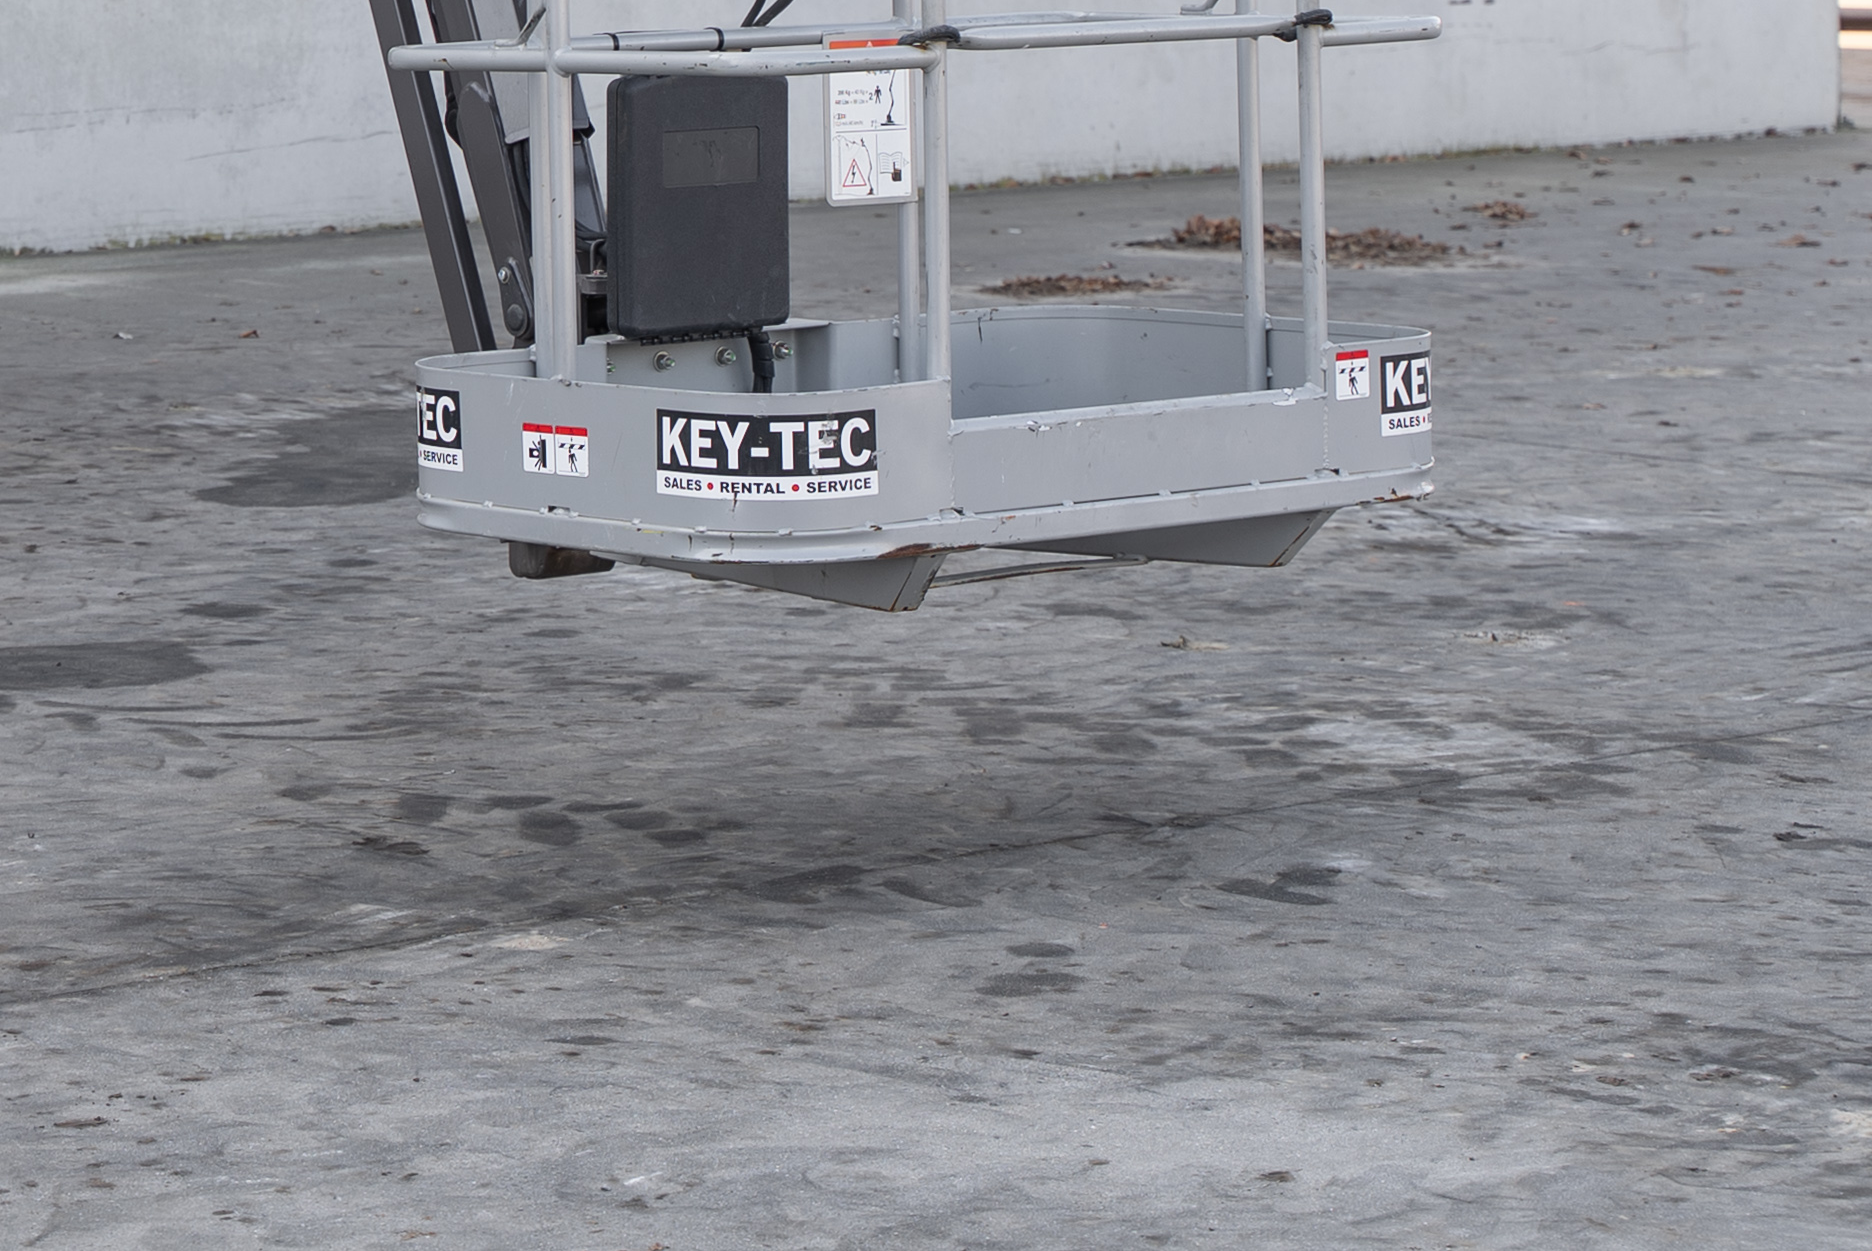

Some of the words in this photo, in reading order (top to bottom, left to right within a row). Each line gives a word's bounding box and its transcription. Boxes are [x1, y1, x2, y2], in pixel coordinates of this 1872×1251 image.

[1388, 415, 1421, 430] SALES
[661, 415, 872, 471] KEY-TEC
[423, 449, 458, 466] SERVICE
[664, 476, 702, 492] SALES
[720, 481, 786, 495] RENTAL
[806, 477, 872, 494] SERVICE
